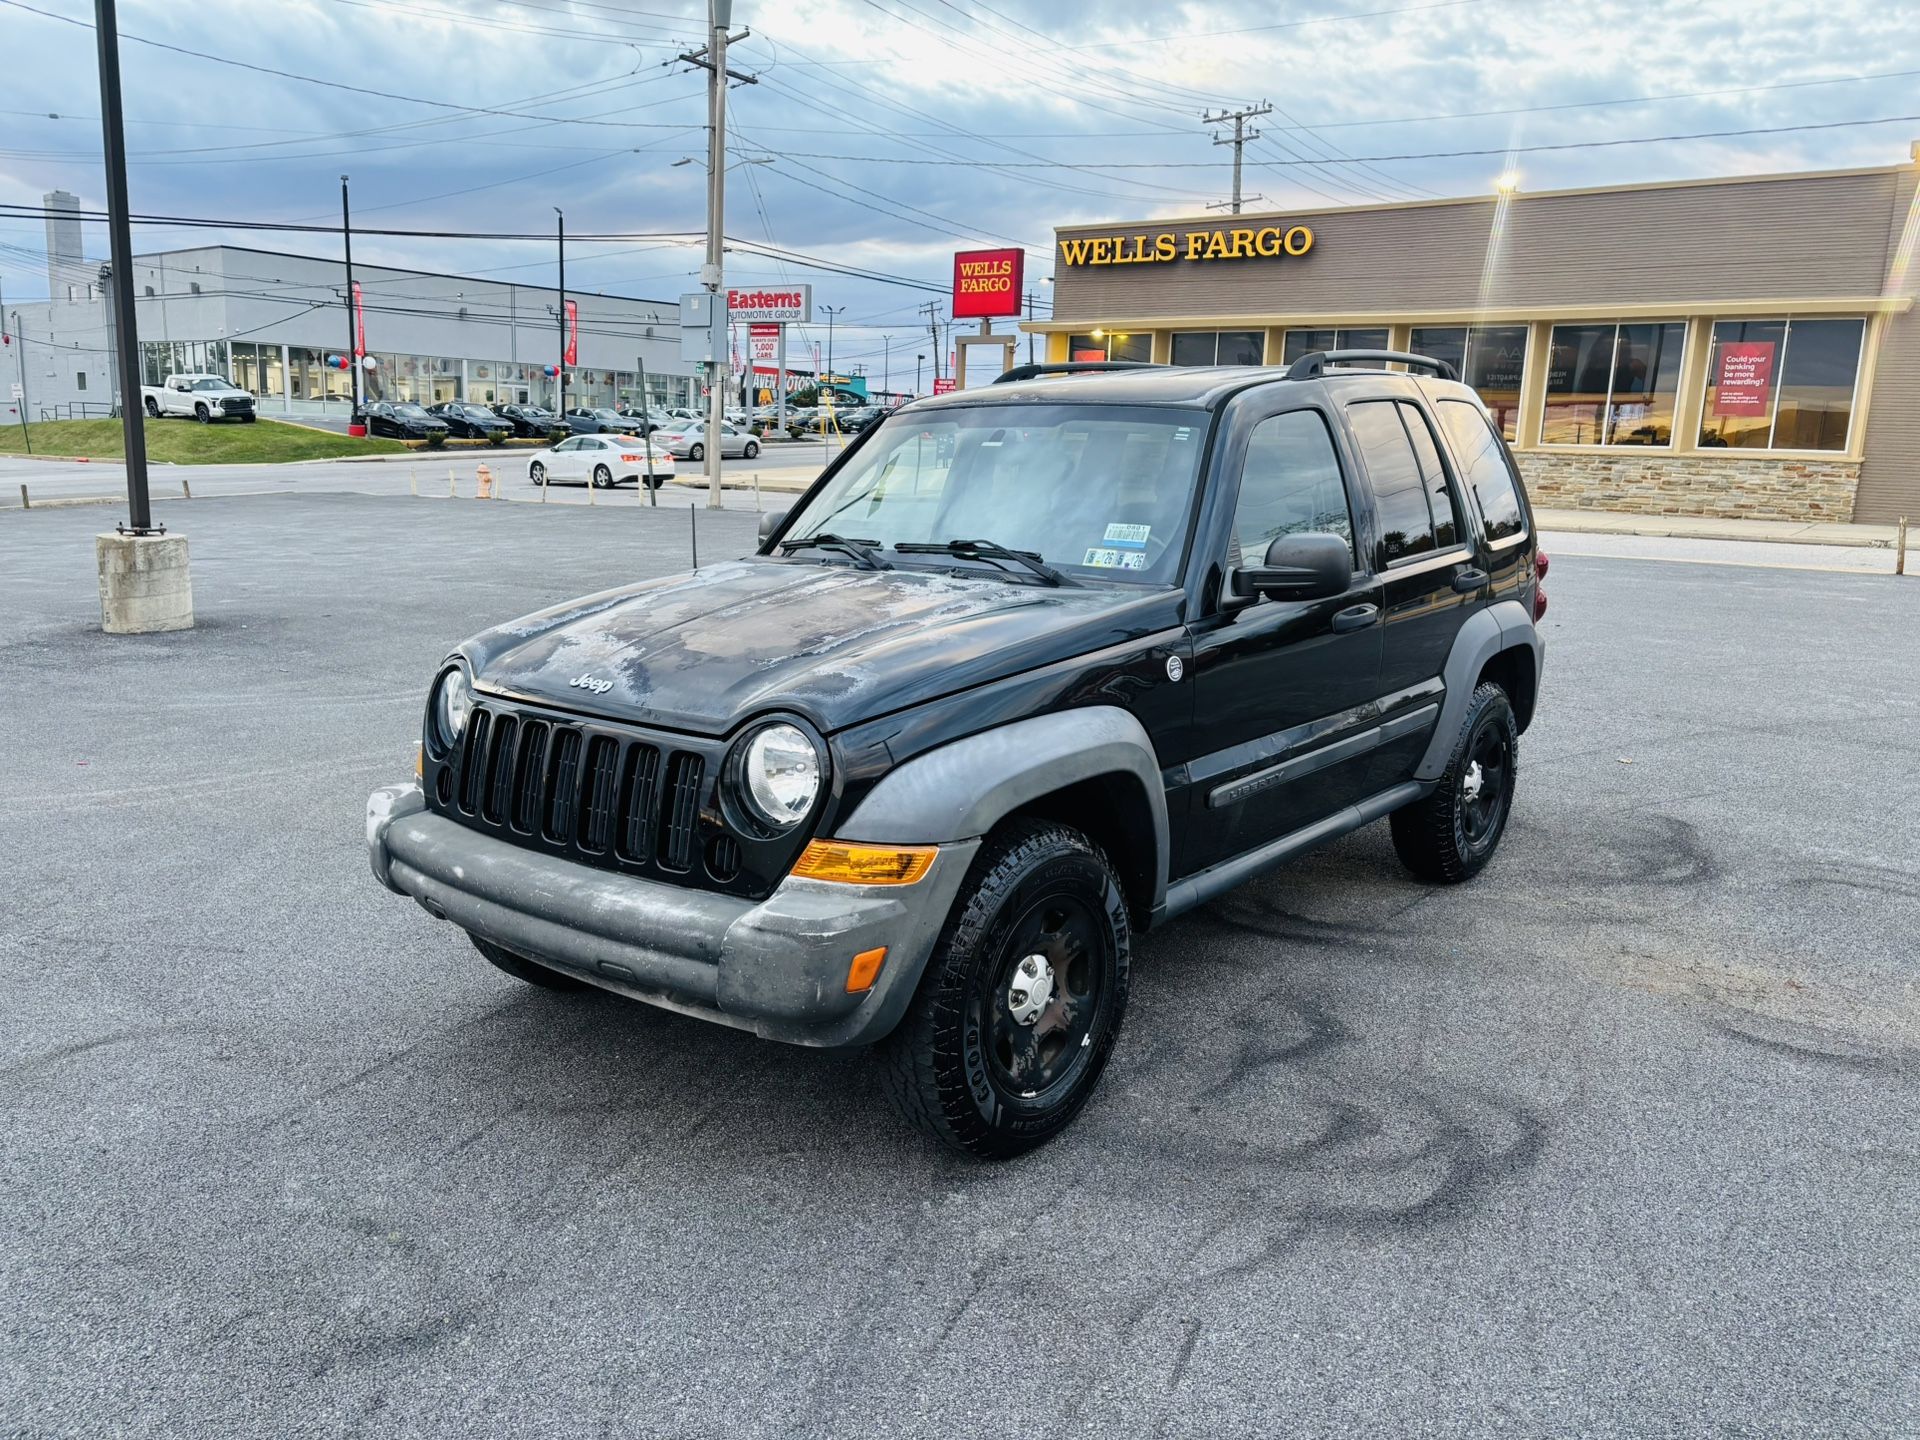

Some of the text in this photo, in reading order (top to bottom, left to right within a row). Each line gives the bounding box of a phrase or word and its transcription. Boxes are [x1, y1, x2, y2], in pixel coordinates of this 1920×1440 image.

[1059, 225, 1314, 266] WELLS FARGO
[960, 260, 1012, 277] WELLS
[960, 277, 1011, 293] FARGO
[728, 290, 802, 309] Easterns
[728, 310, 801, 319] AUTOMOTIVE GROUP
[1725, 363, 1755, 371] banking
[1726, 355, 1766, 364] Could your
[743, 372, 777, 389] AVEN
[778, 375, 816, 391] OTORS
[1723, 378, 1764, 387] rewarding?
[569, 673, 614, 695] Jeep
[1229, 770, 1285, 800] LIBERTY
